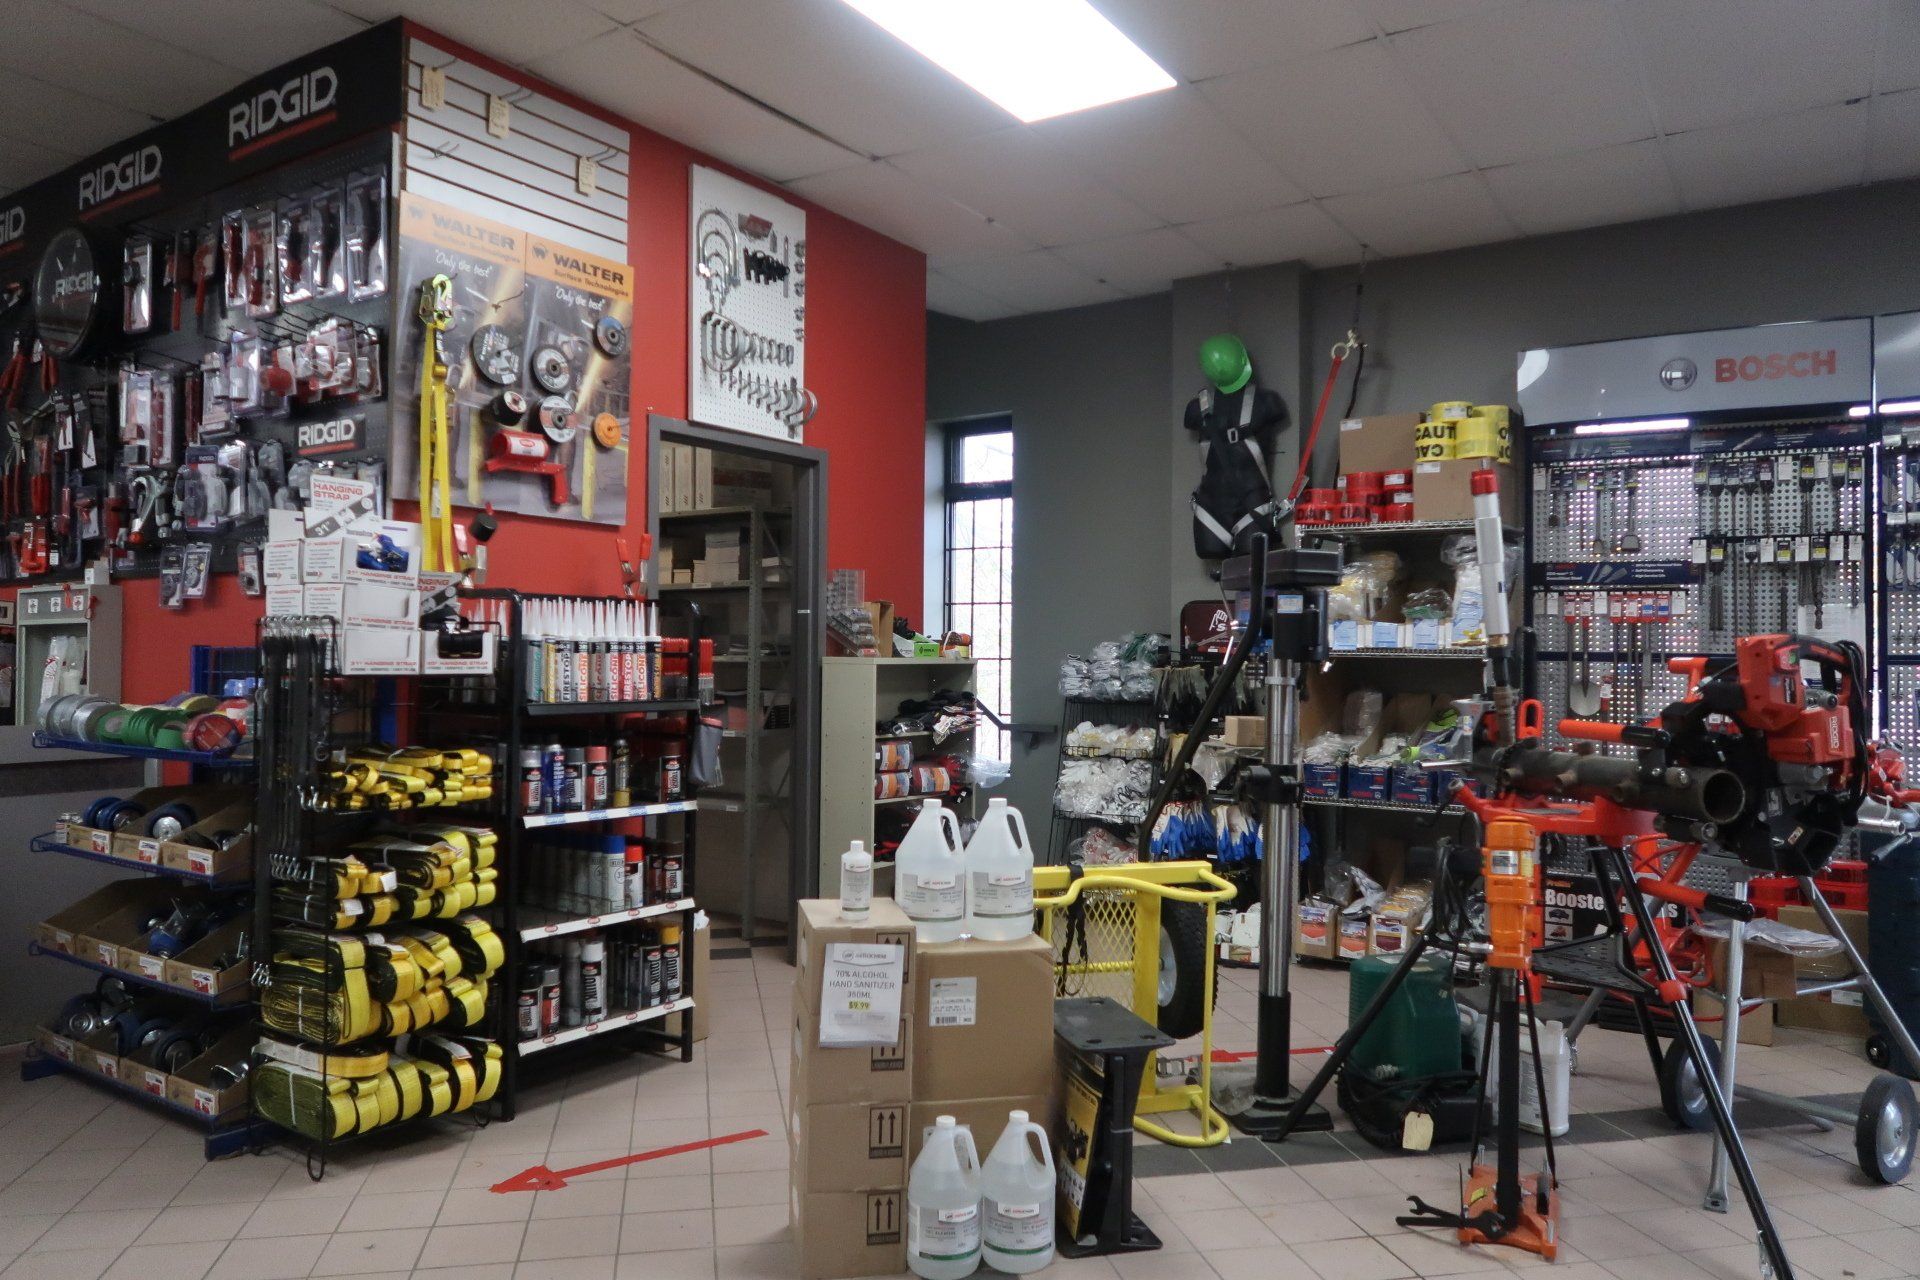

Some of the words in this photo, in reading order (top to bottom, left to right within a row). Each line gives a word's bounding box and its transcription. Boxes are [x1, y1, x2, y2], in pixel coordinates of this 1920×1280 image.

[228, 66, 339, 147] RIDGID
[79, 145, 163, 210] RIDGID
[432, 212, 515, 250] WALTER
[553, 252, 624, 286] WALTER
[554, 268, 583, 284] Surface
[584, 277, 629, 298] Technologies
[1714, 349, 1838, 384] BOSCH
[298, 418, 356, 449] RIDGID
[313, 481, 364, 496] HANGING
[313, 490, 351, 501] STRAP
[563, 652, 571, 700] FIRESTOP
[579, 653, 587, 700] SILICONE
[624, 653, 632, 700] FIRESTOP
[1831, 715, 1840, 750] RIDGID
[1544, 888, 1606, 911] Booste
[829, 980, 852, 989] HAND
[853, 980, 896, 990] SANITIZER
[835, 970, 851, 978] 70%
[852, 970, 889, 979] ALCOHOL
[848, 1001, 870, 1010] $9.99
